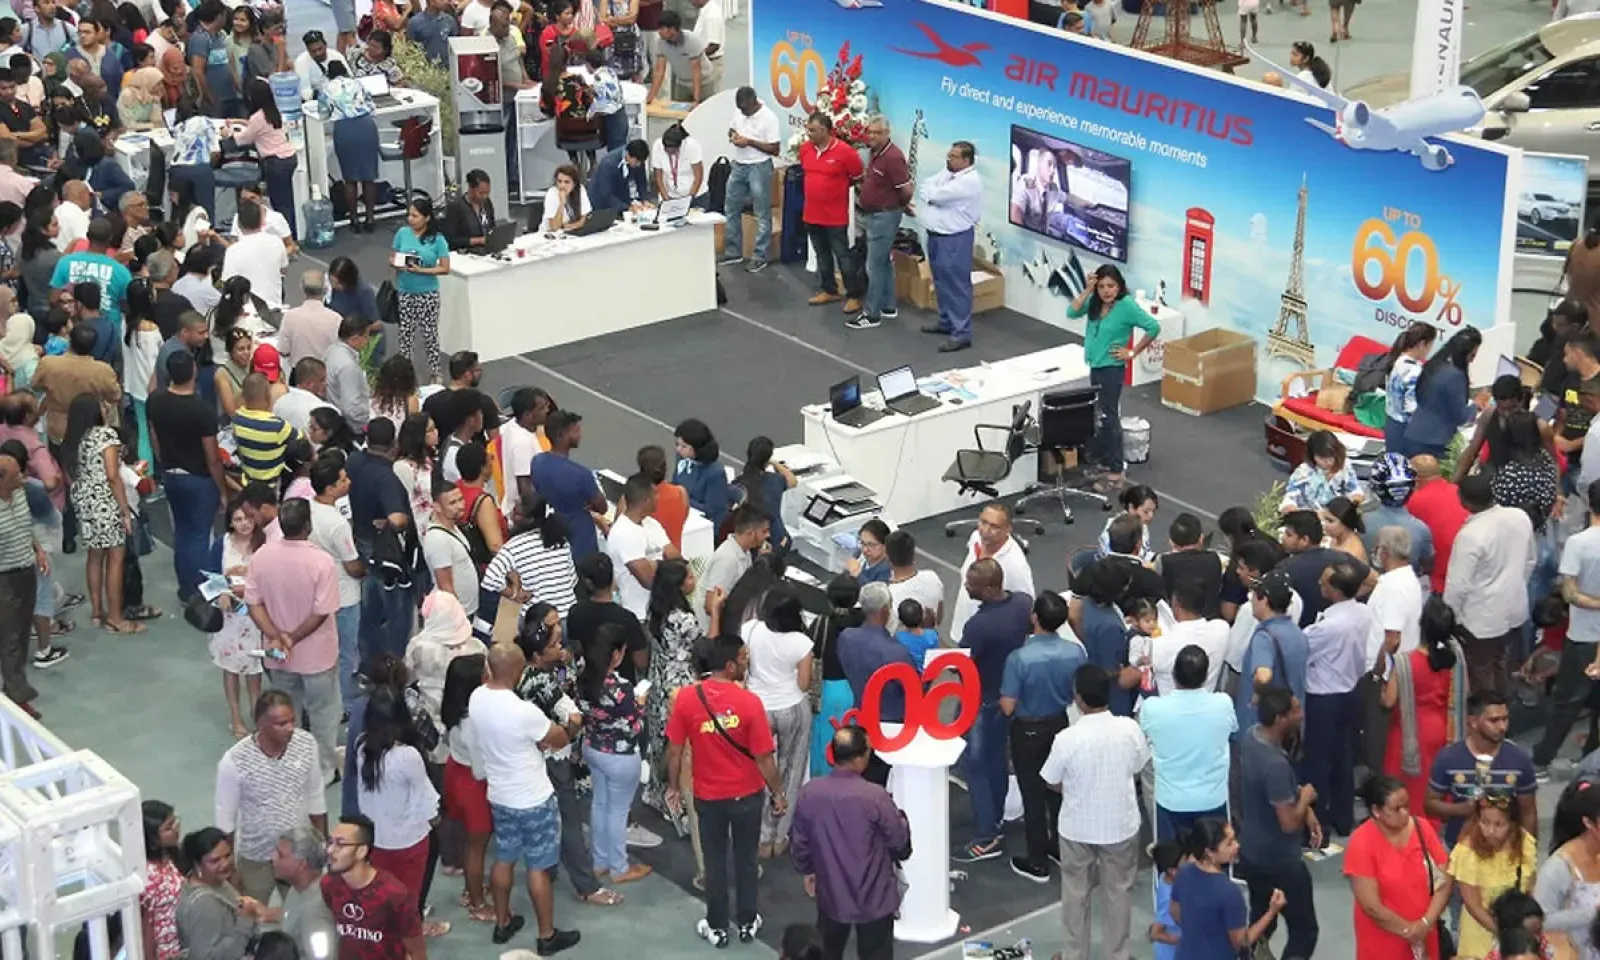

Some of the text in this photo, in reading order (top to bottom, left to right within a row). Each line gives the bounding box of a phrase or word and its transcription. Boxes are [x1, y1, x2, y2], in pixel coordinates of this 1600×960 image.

[941, 76, 1208, 169] Fly direct and experience memorable moments
[1383, 205, 1422, 229] UP TO
